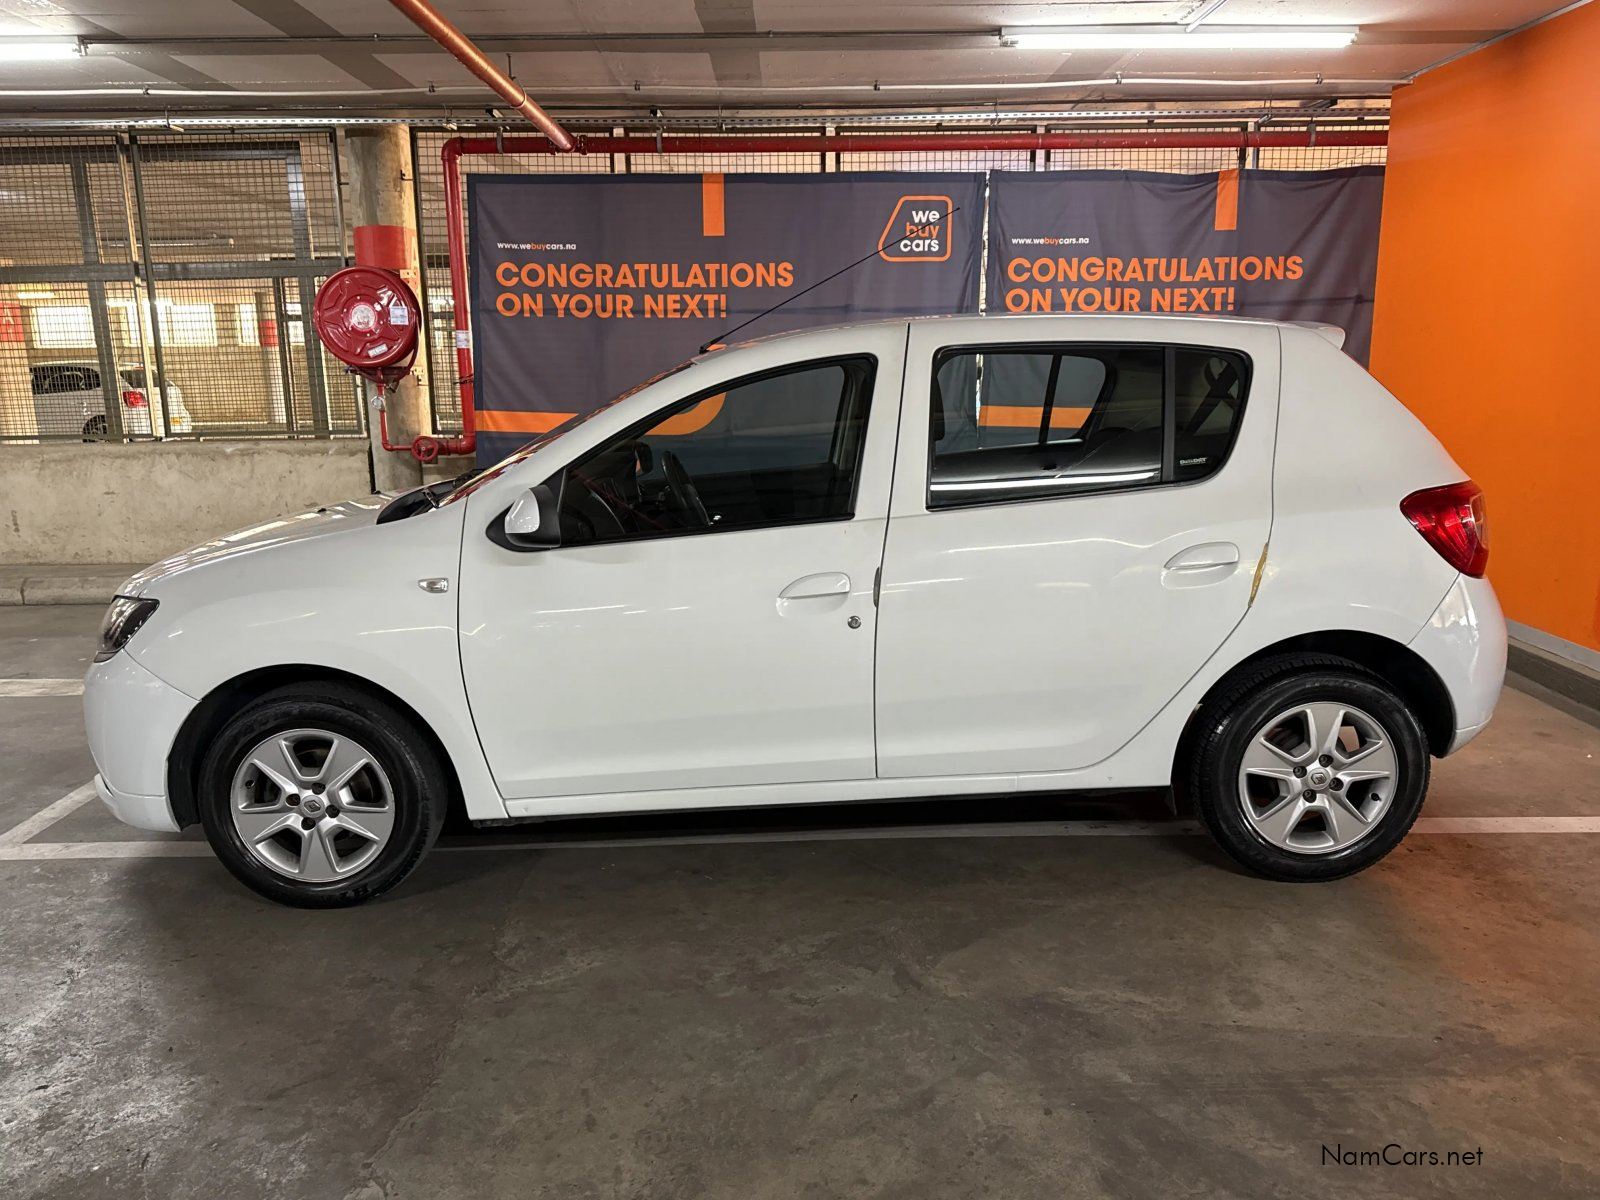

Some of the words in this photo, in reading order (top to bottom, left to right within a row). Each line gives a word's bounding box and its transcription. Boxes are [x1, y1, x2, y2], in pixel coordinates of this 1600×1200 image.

[912, 210, 940, 223] we
[906, 222, 939, 238] buy
[497, 242, 577, 251] www.webuycars.na
[900, 239, 939, 252] cars
[1011, 237, 1090, 246] www.webuycars.na
[496, 261, 794, 288] CONGRATULATIONS
[1007, 256, 1304, 282] CONGRATULATIONS
[496, 292, 543, 317] ON
[551, 294, 634, 318] YOUR
[644, 294, 727, 318] NEXT!
[1005, 288, 1052, 312] ON
[1060, 287, 1141, 312] YOUR
[1151, 287, 1235, 312] NEXT!
